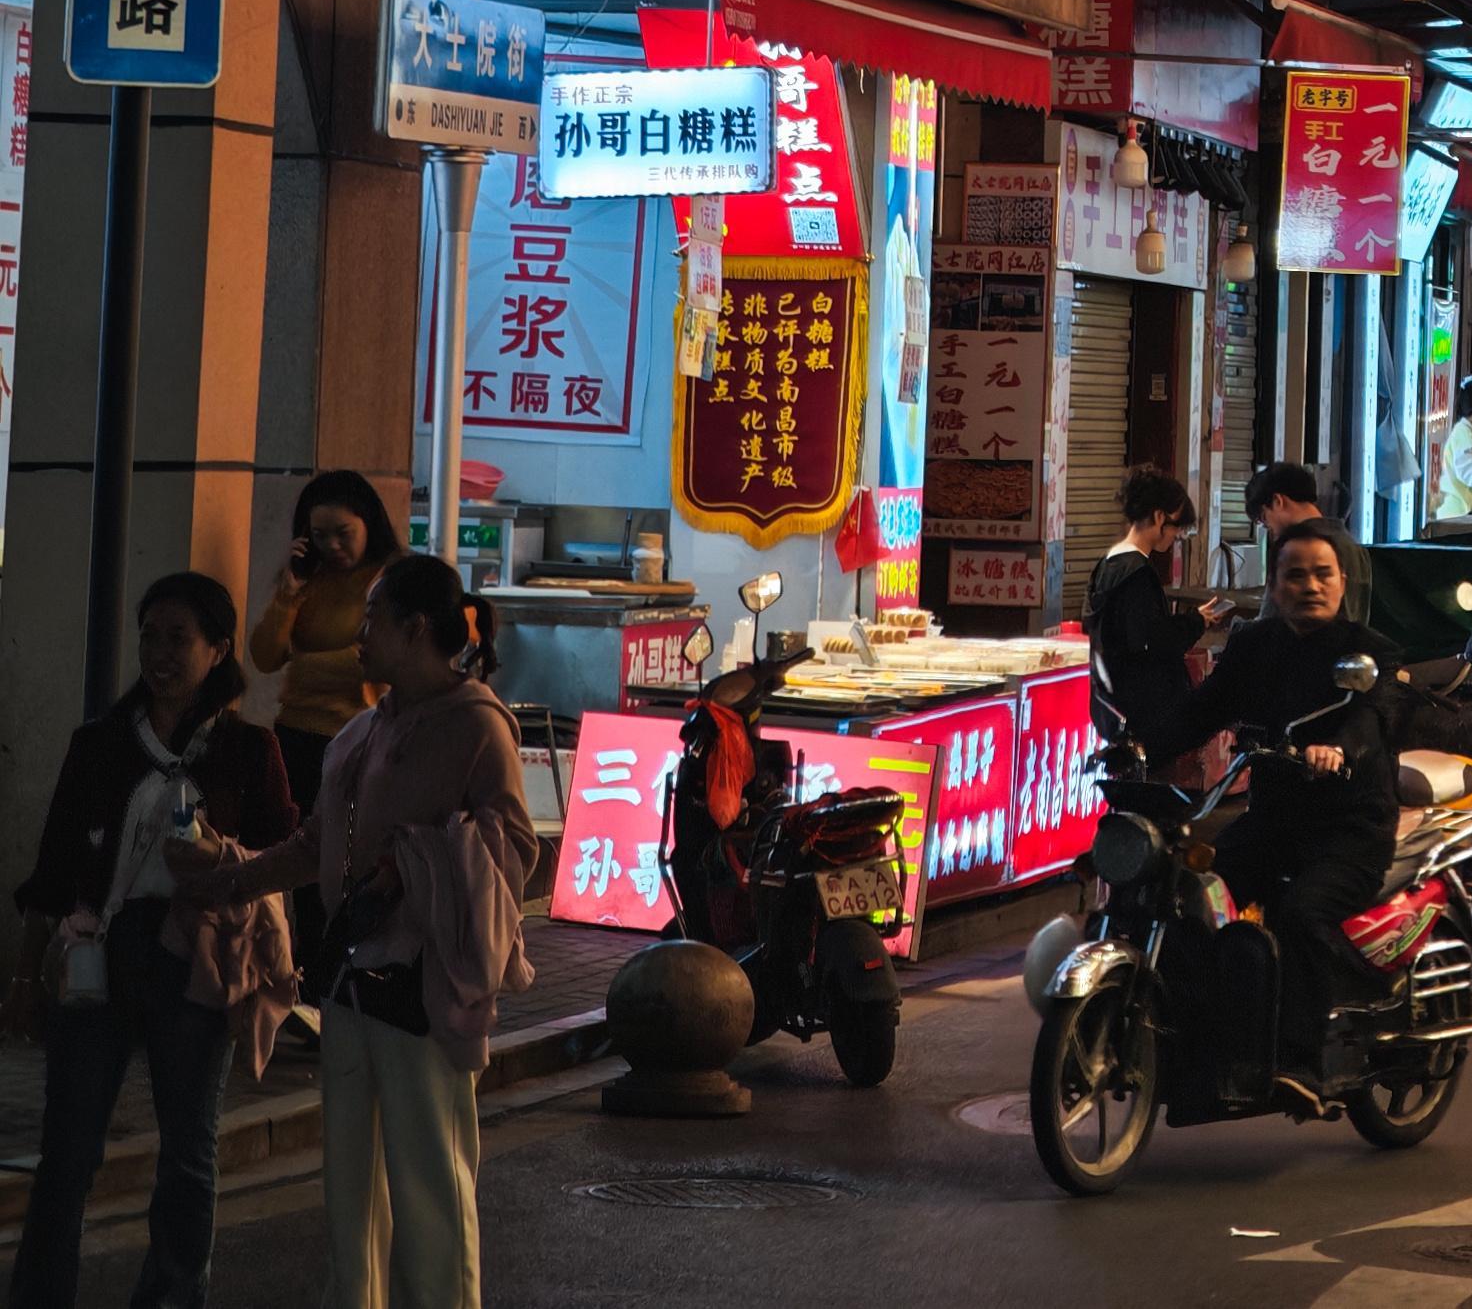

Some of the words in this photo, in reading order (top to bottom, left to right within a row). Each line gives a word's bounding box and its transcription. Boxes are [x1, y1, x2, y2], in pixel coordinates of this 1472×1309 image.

[412, 8, 527, 83] 大士院街
[551, 85, 633, 106] 手作正宗
[1302, 88, 1350, 107] 老字号
[431, 102, 487, 134] DASHIYUAN
[490, 111, 503, 137] JIE
[518, 115, 528, 141] 西
[555, 107, 758, 158] 孙哥白糖糕
[757, 41, 839, 205] 哥糕点
[1304, 120, 1345, 141] 手工
[648, 163, 759, 182] 三代传承排队购
[1355, 102, 1400, 264] 一元一个
[806, 291, 834, 372] 白糖糕
[464, 370, 603, 417] 不隔夜
[740, 292, 769, 494] 非物质文化遗产
[770, 291, 801, 490] 已评为南昌市级
[981, 333, 1022, 465] 一元一个
[827, 887, 896, 916] C4612
